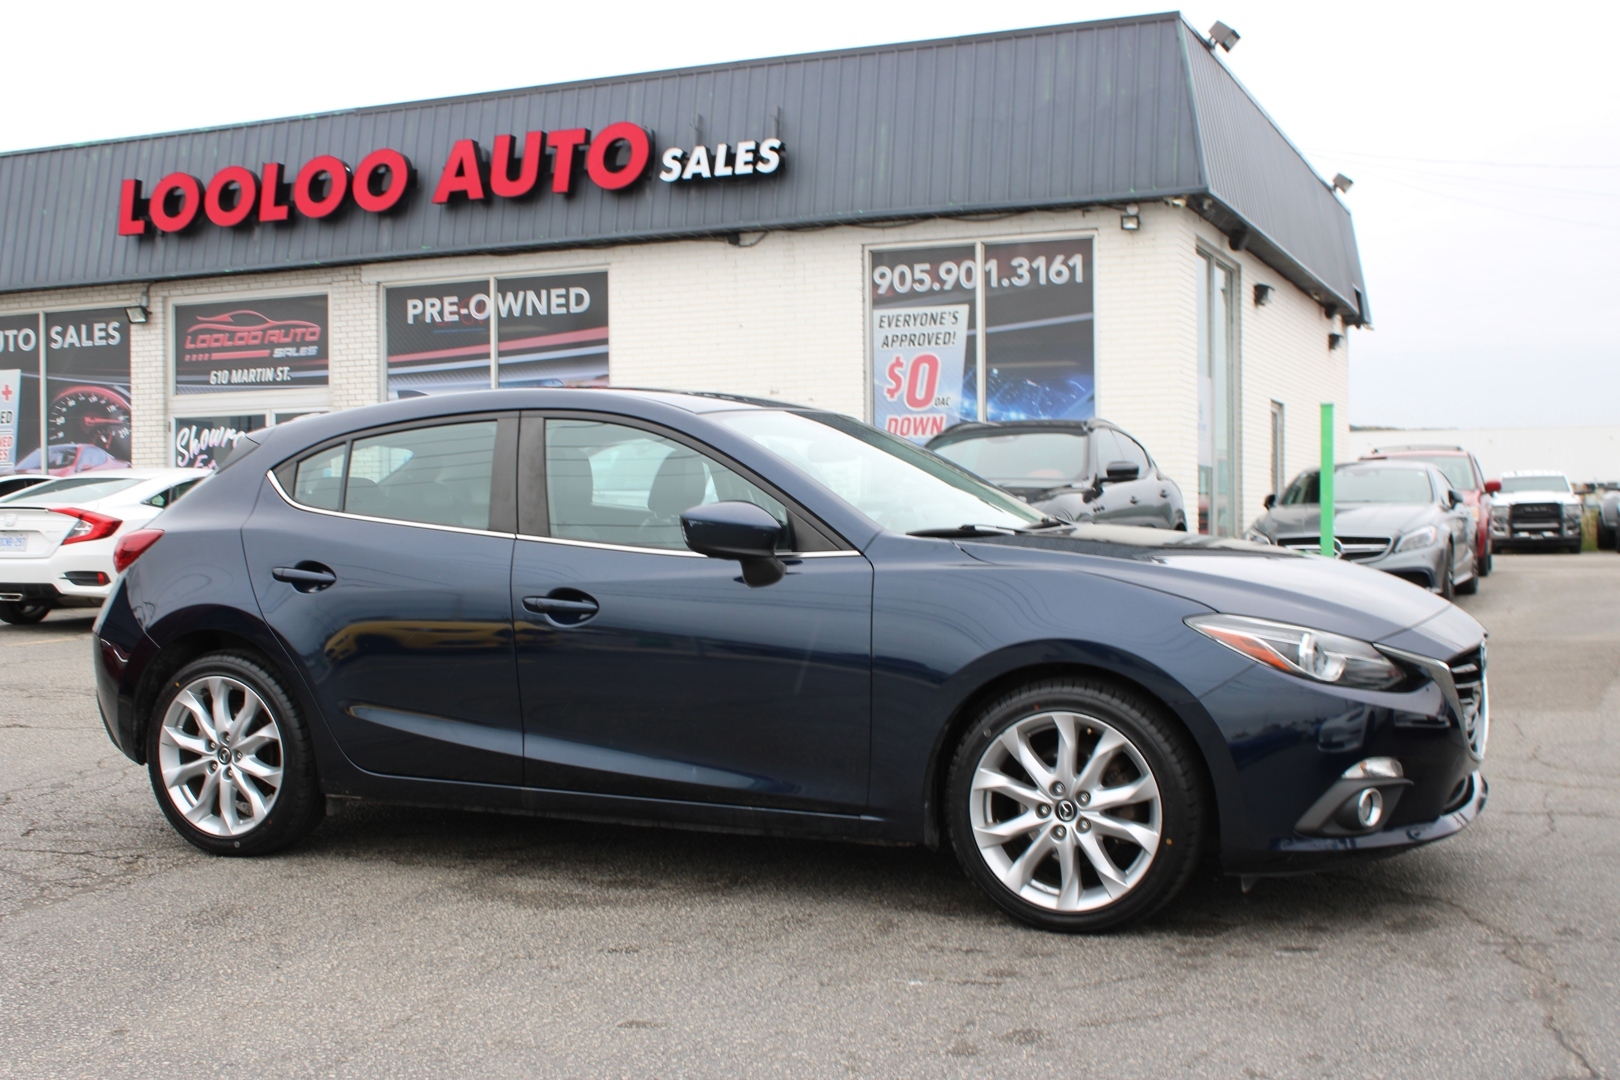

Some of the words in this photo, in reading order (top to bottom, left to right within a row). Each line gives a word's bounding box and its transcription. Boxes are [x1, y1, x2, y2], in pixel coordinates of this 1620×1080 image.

[118, 148, 409, 236] LOOLOO
[431, 121, 650, 204] AUTO
[659, 138, 782, 184] SALES
[873, 253, 1084, 295] 905.901.3161
[407, 286, 591, 325] PRE-OWNED
[878, 311, 960, 329] EVERYONE'S
[50, 320, 121, 350] SALES
[184, 330, 264, 350] LOOLOO
[264, 327, 321, 345] AUTO
[881, 331, 957, 349] APPROVED!
[273, 345, 319, 358] SALES
[209, 369, 229, 385] 610
[230, 366, 275, 384] MARTIN
[275, 366, 292, 382] ST.
[885, 353, 940, 409] $0
[886, 415, 945, 437] DOWN
